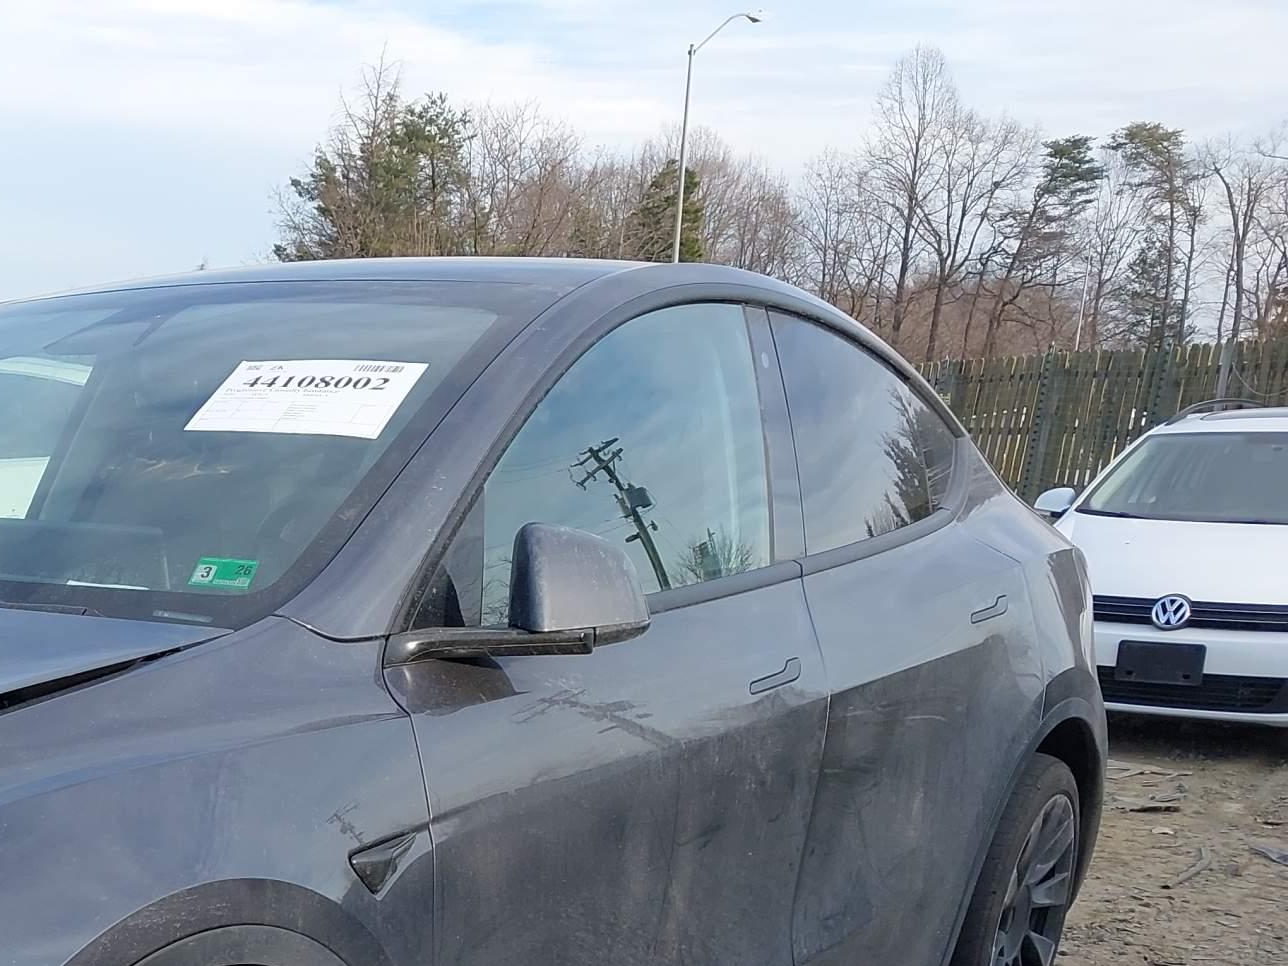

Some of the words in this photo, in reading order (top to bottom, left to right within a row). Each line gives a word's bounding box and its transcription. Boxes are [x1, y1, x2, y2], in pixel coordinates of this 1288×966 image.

[242, 375, 390, 390] 44108002
[200, 566, 212, 578] 3
[235, 565, 253, 576] 26
[1154, 597, 1189, 627] VW
